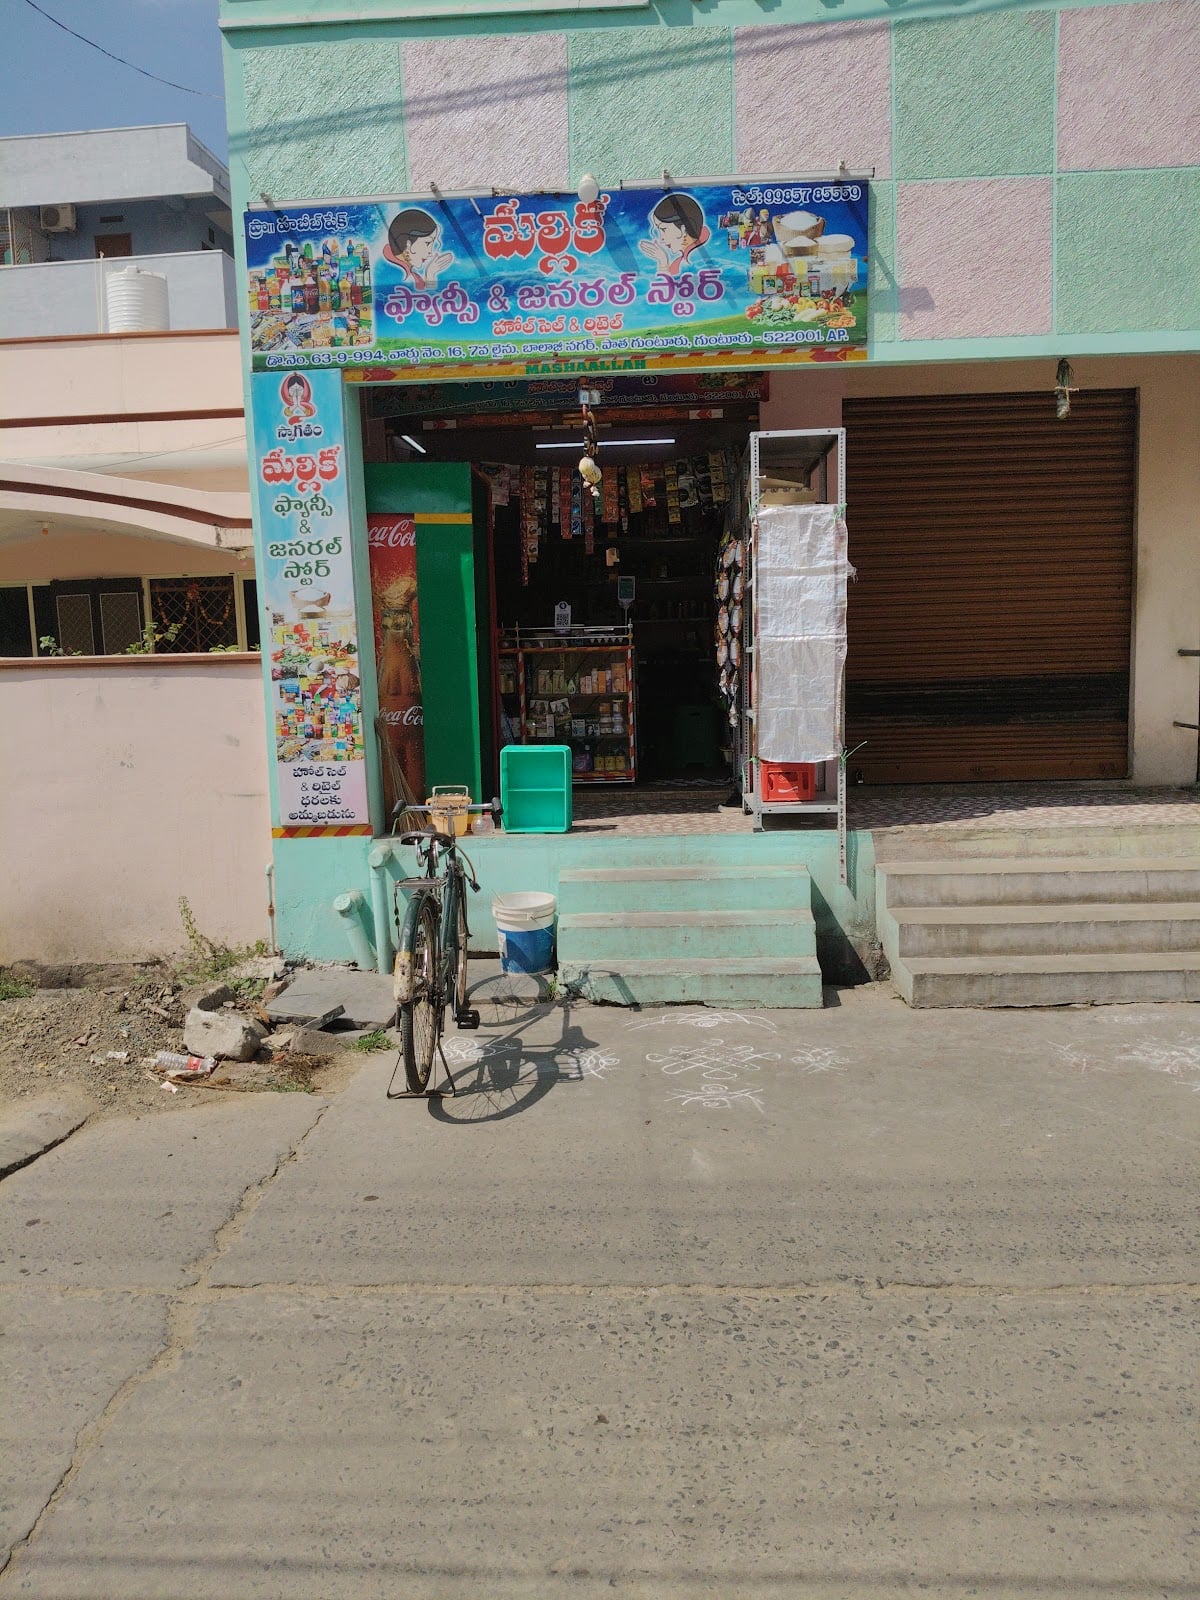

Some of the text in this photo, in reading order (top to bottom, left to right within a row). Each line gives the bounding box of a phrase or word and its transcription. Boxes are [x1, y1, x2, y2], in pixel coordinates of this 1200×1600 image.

[812, 185, 861, 202] 85559
[324, 212, 348, 233] షేక్
[384, 268, 724, 326] ఫ్యాన్సీ & జనరల్ స్టోర్
[538, 315, 566, 333] సెల్
[568, 317, 581, 332] &
[583, 313, 624, 336] రిటైల్
[448, 345, 466, 359] 16,
[601, 337, 629, 350] పాత
[694, 333, 753, 348] గుంటూరు
[525, 359, 646, 375] MASHAALLAH
[277, 424, 322, 442] స్వాగతం
[262, 445, 341, 493] మల్లిక
[274, 493, 333, 518] ఫ్యాన్సీ
[299, 519, 312, 535] &
[269, 536, 343, 557] జనరల్
[284, 559, 331, 586] స్టోర్
[326, 765, 347, 777] సెల్
[300, 780, 341, 795] & రిటైల్
[301, 795, 342, 808] ధరలకు
[288, 808, 356, 823] అమ్మబడును
